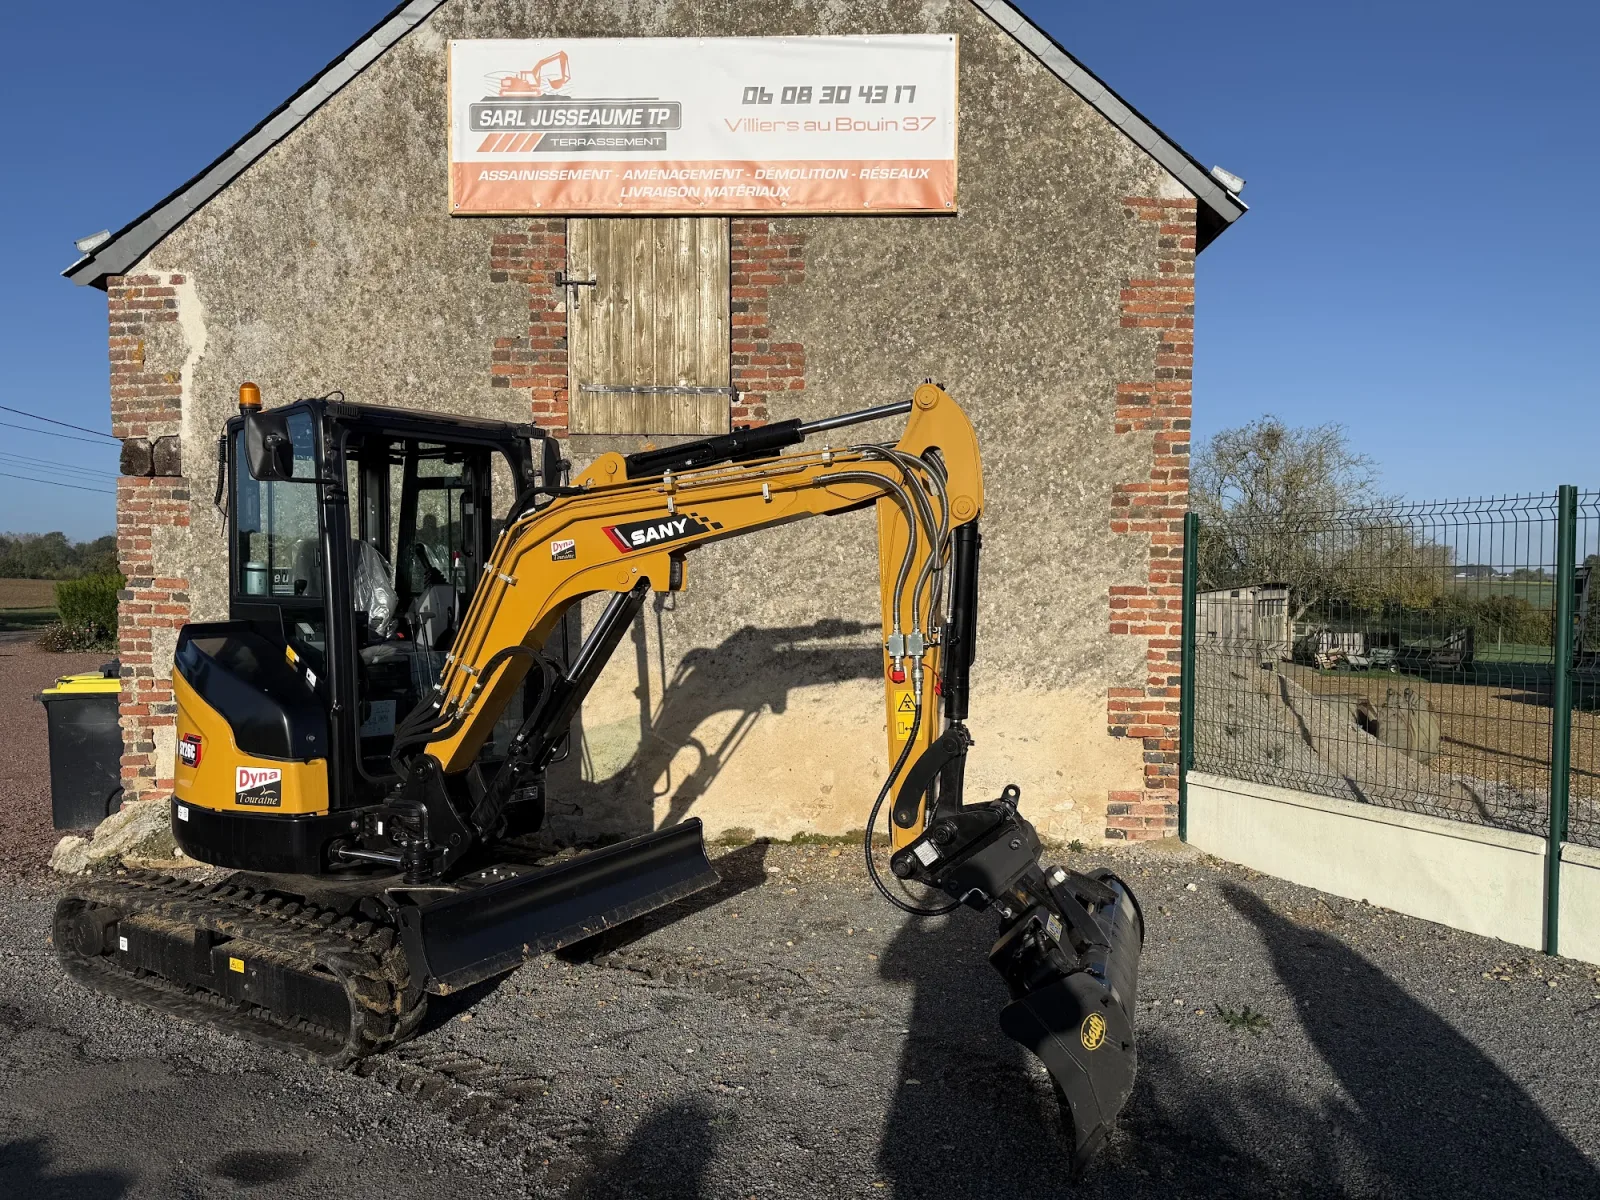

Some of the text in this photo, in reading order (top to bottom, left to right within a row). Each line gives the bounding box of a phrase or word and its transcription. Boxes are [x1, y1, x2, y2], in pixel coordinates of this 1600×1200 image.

[742, 85, 916, 104] 06 08 30 43 17
[479, 108, 670, 127] SARL JUSSEAUME TP
[724, 117, 936, 132] Villiers au Bouin 37
[550, 137, 663, 147] TERRASSEMENT
[478, 169, 612, 181] ASSAINISSEMENT
[622, 166, 744, 180] AMÉNAGEMENT
[754, 166, 848, 180] DÉMOLITION
[859, 166, 930, 179] RÉSEAUX
[620, 184, 791, 198] LIVRAISON MATÉRIAUX
[630, 518, 687, 546] SANY
[552, 540, 573, 552] Dyna
[239, 769, 278, 788] Dyna
[237, 792, 278, 805] Touraine
